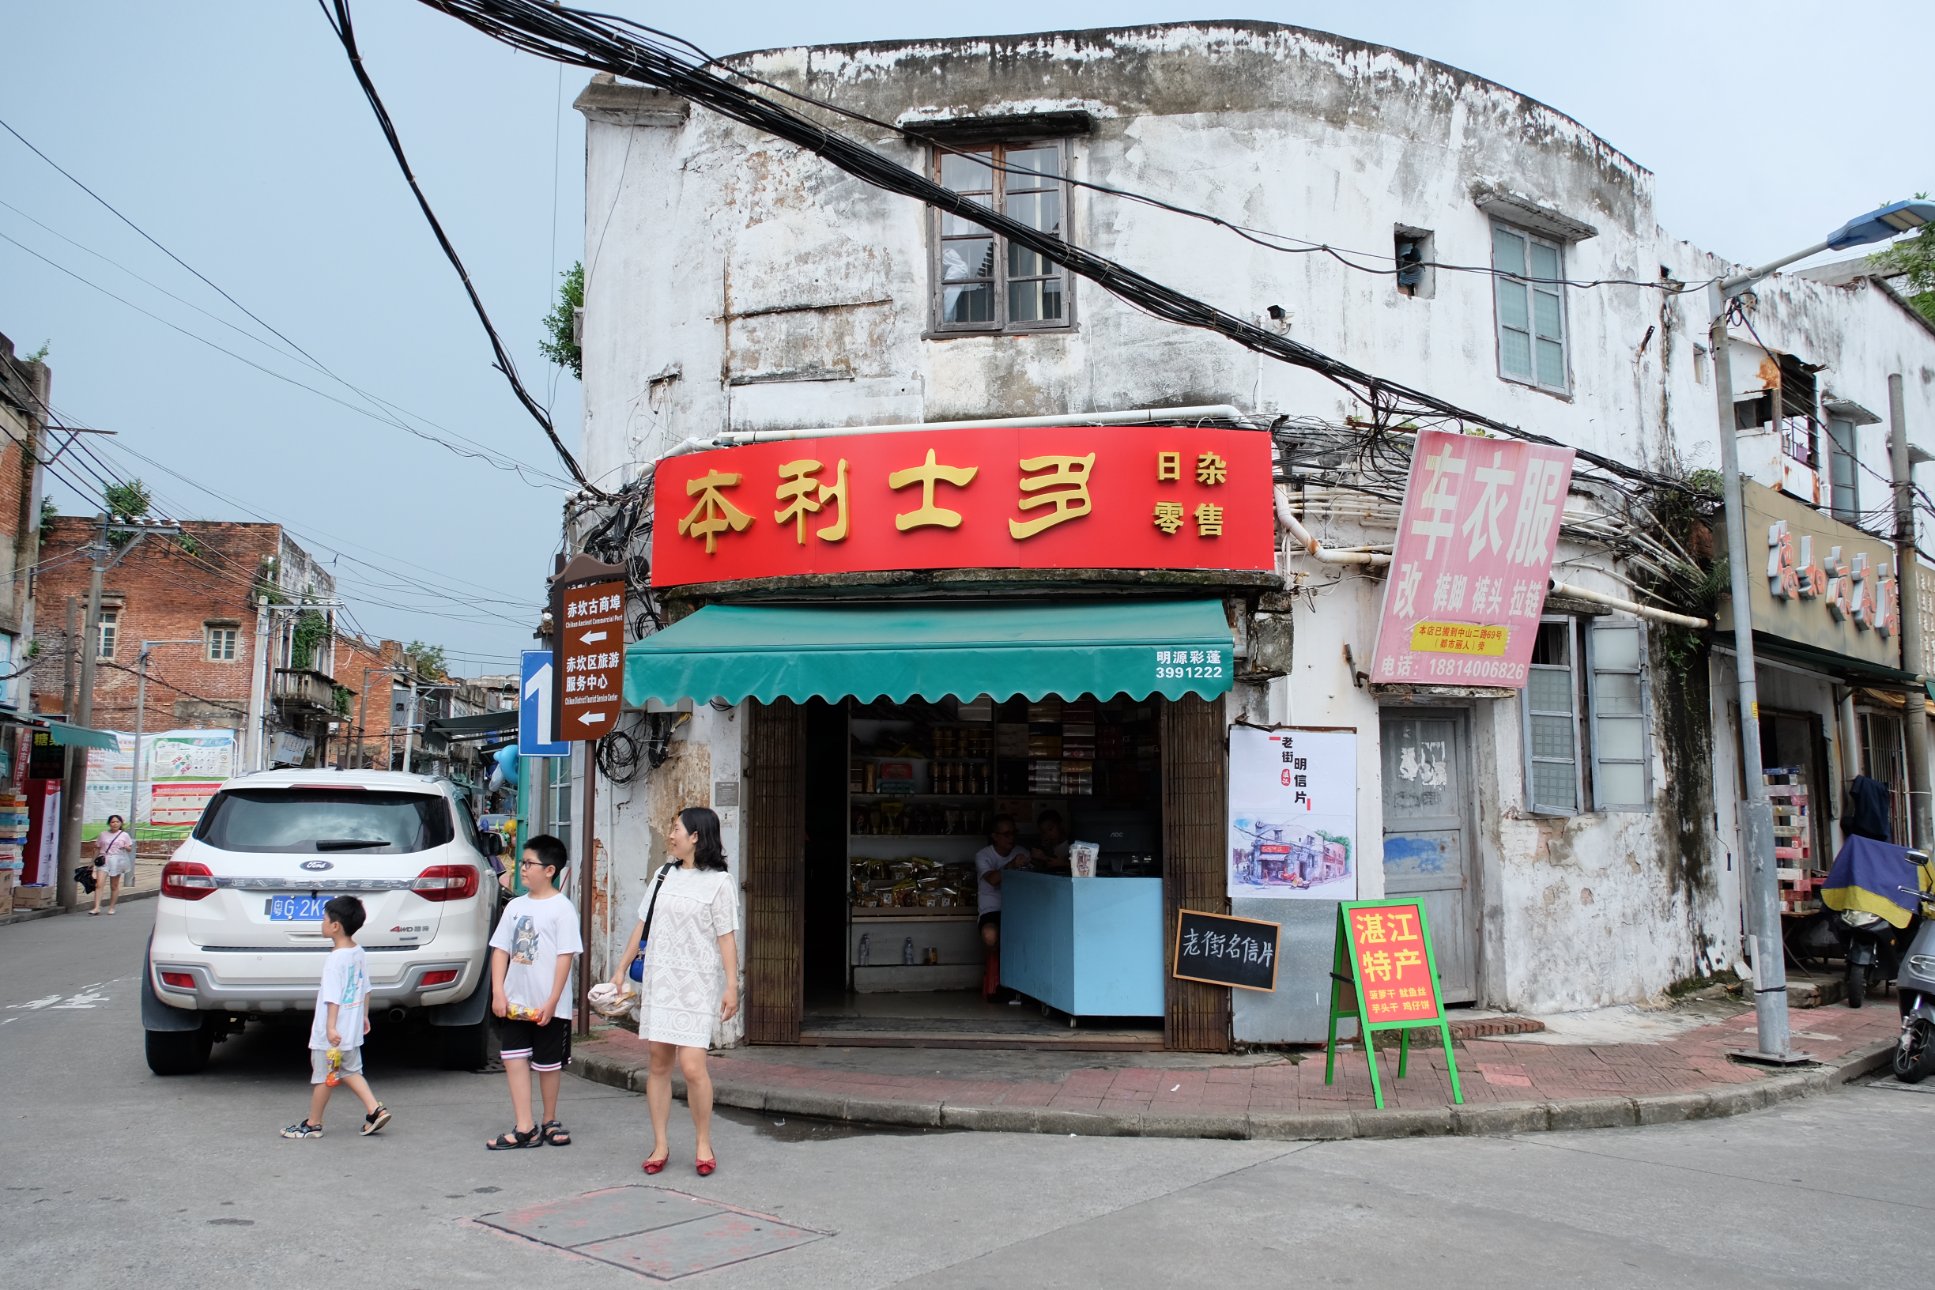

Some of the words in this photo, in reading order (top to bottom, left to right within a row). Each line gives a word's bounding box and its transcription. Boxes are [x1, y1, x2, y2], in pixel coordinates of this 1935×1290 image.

[1157, 450, 1227, 485] 日杂
[678, 447, 1096, 555] 本利士多
[1411, 443, 1565, 567] 车衣服
[1153, 501, 1224, 537] 零售
[567, 593, 621, 618] 赤坎古商埠
[1393, 561, 1422, 619] 改
[1432, 572, 1468, 612] 裤脚
[1472, 575, 1502, 615] 裤头
[1508, 578, 1543, 618] 拉链
[1419, 625, 1502, 640] 本店已搬到中山二路69号
[566, 651, 620, 673] 赤坎区旅游
[1155, 666, 1223, 679] 3991222
[1429, 658, 1525, 680] 18814006826
[566, 673, 608, 692] 服务中心
[1281, 736, 1293, 763] 老街
[1293, 757, 1307, 804] 明信片
[1356, 913, 1418, 945] 湛江
[1183, 928, 1273, 967] 老街名信片
[1363, 949, 1421, 982] 特产
